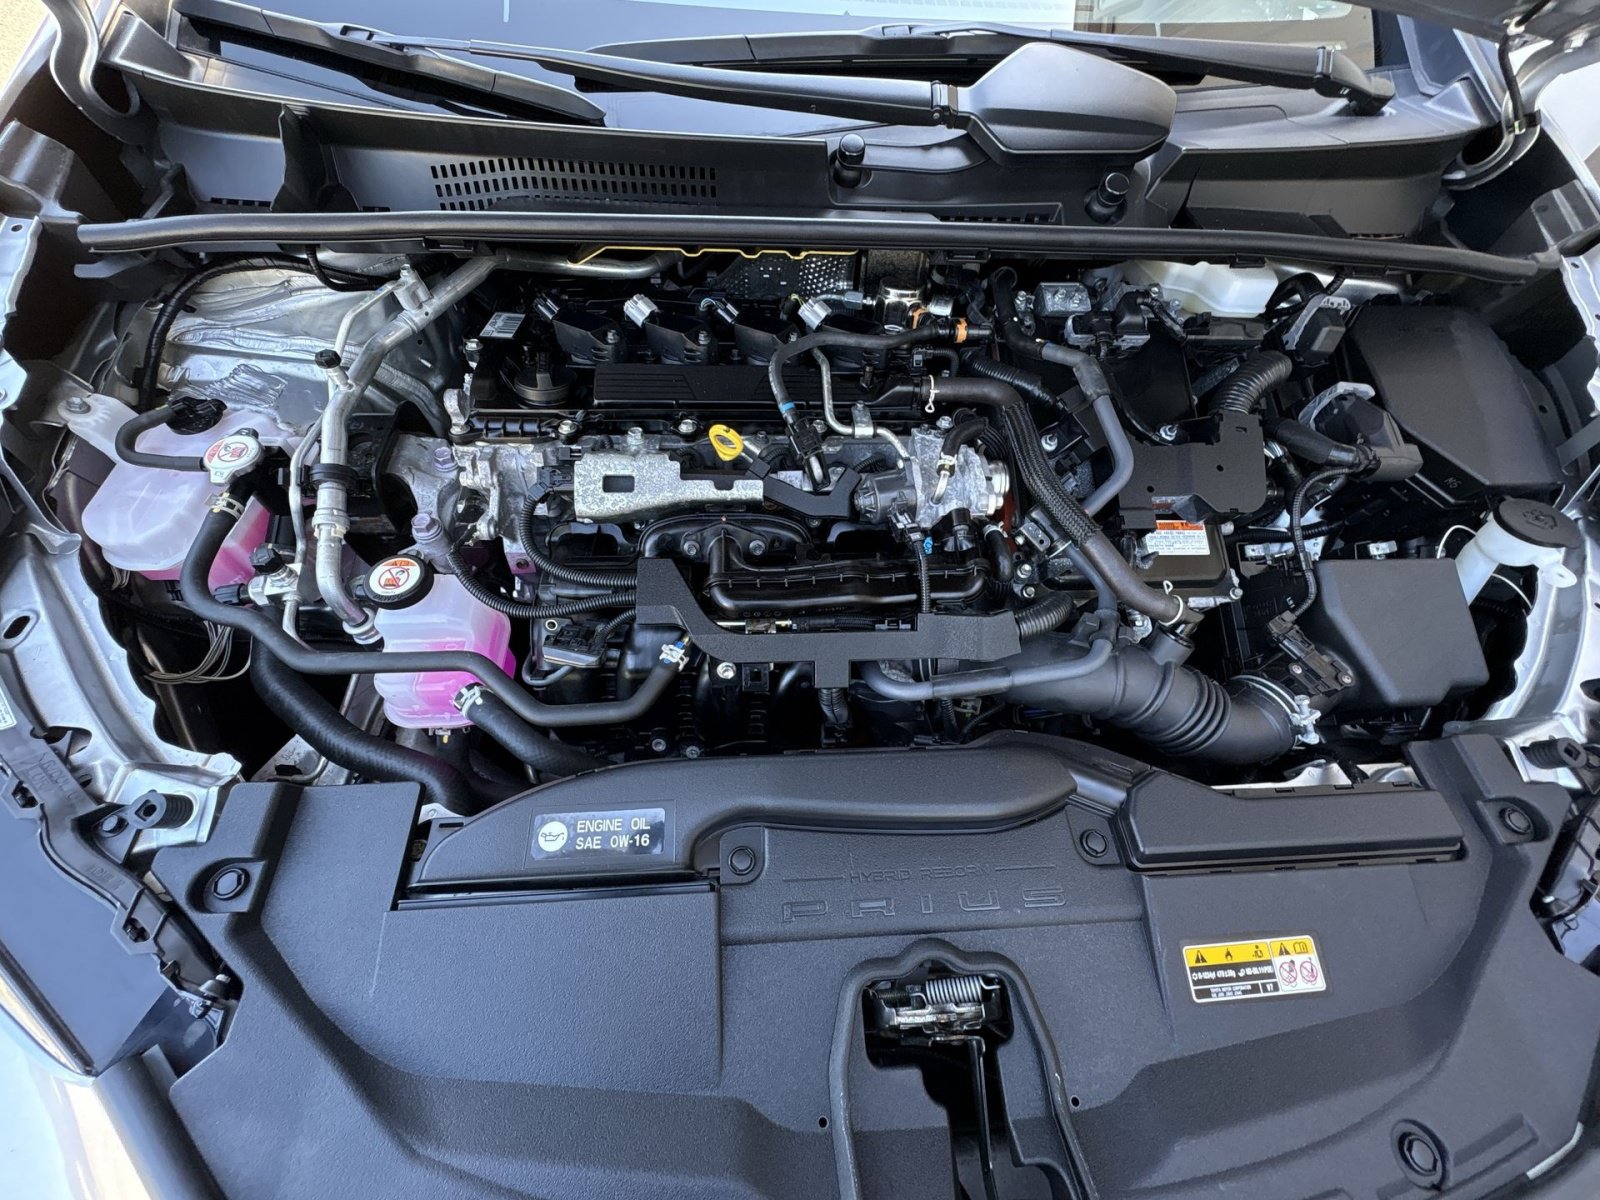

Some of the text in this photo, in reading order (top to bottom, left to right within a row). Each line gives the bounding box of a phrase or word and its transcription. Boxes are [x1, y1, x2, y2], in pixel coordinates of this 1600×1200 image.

[577, 817, 651, 833] ENGINE OIL
[575, 834, 650, 850] SAE 0W-16
[850, 865, 989, 883] HYBRID REBORN
[781, 887, 1067, 923] PRIUS
